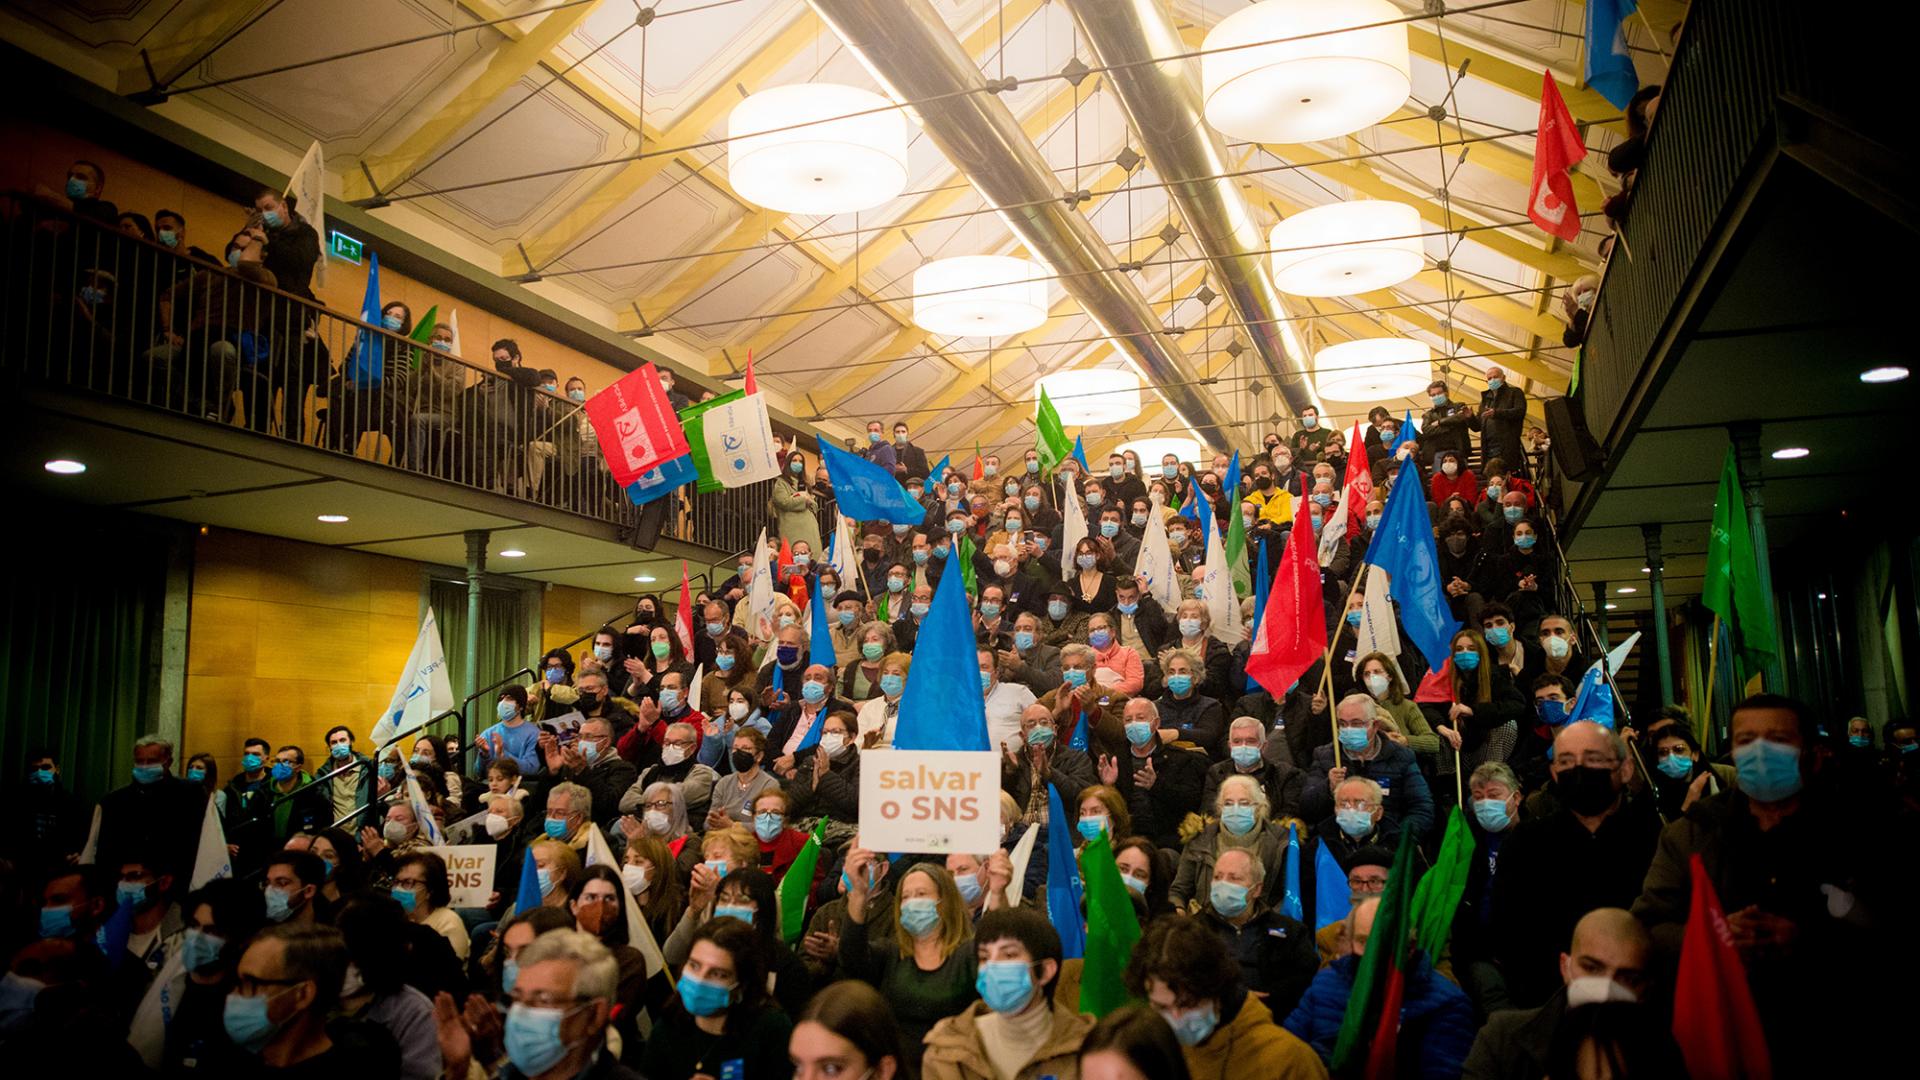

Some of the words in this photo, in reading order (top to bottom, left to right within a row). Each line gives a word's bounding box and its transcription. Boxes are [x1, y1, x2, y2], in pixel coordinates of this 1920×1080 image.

[879, 764, 982, 791] salvar
[880, 800, 901, 820] o
[911, 796, 980, 821] SNS
[447, 854, 485, 869] lvar
